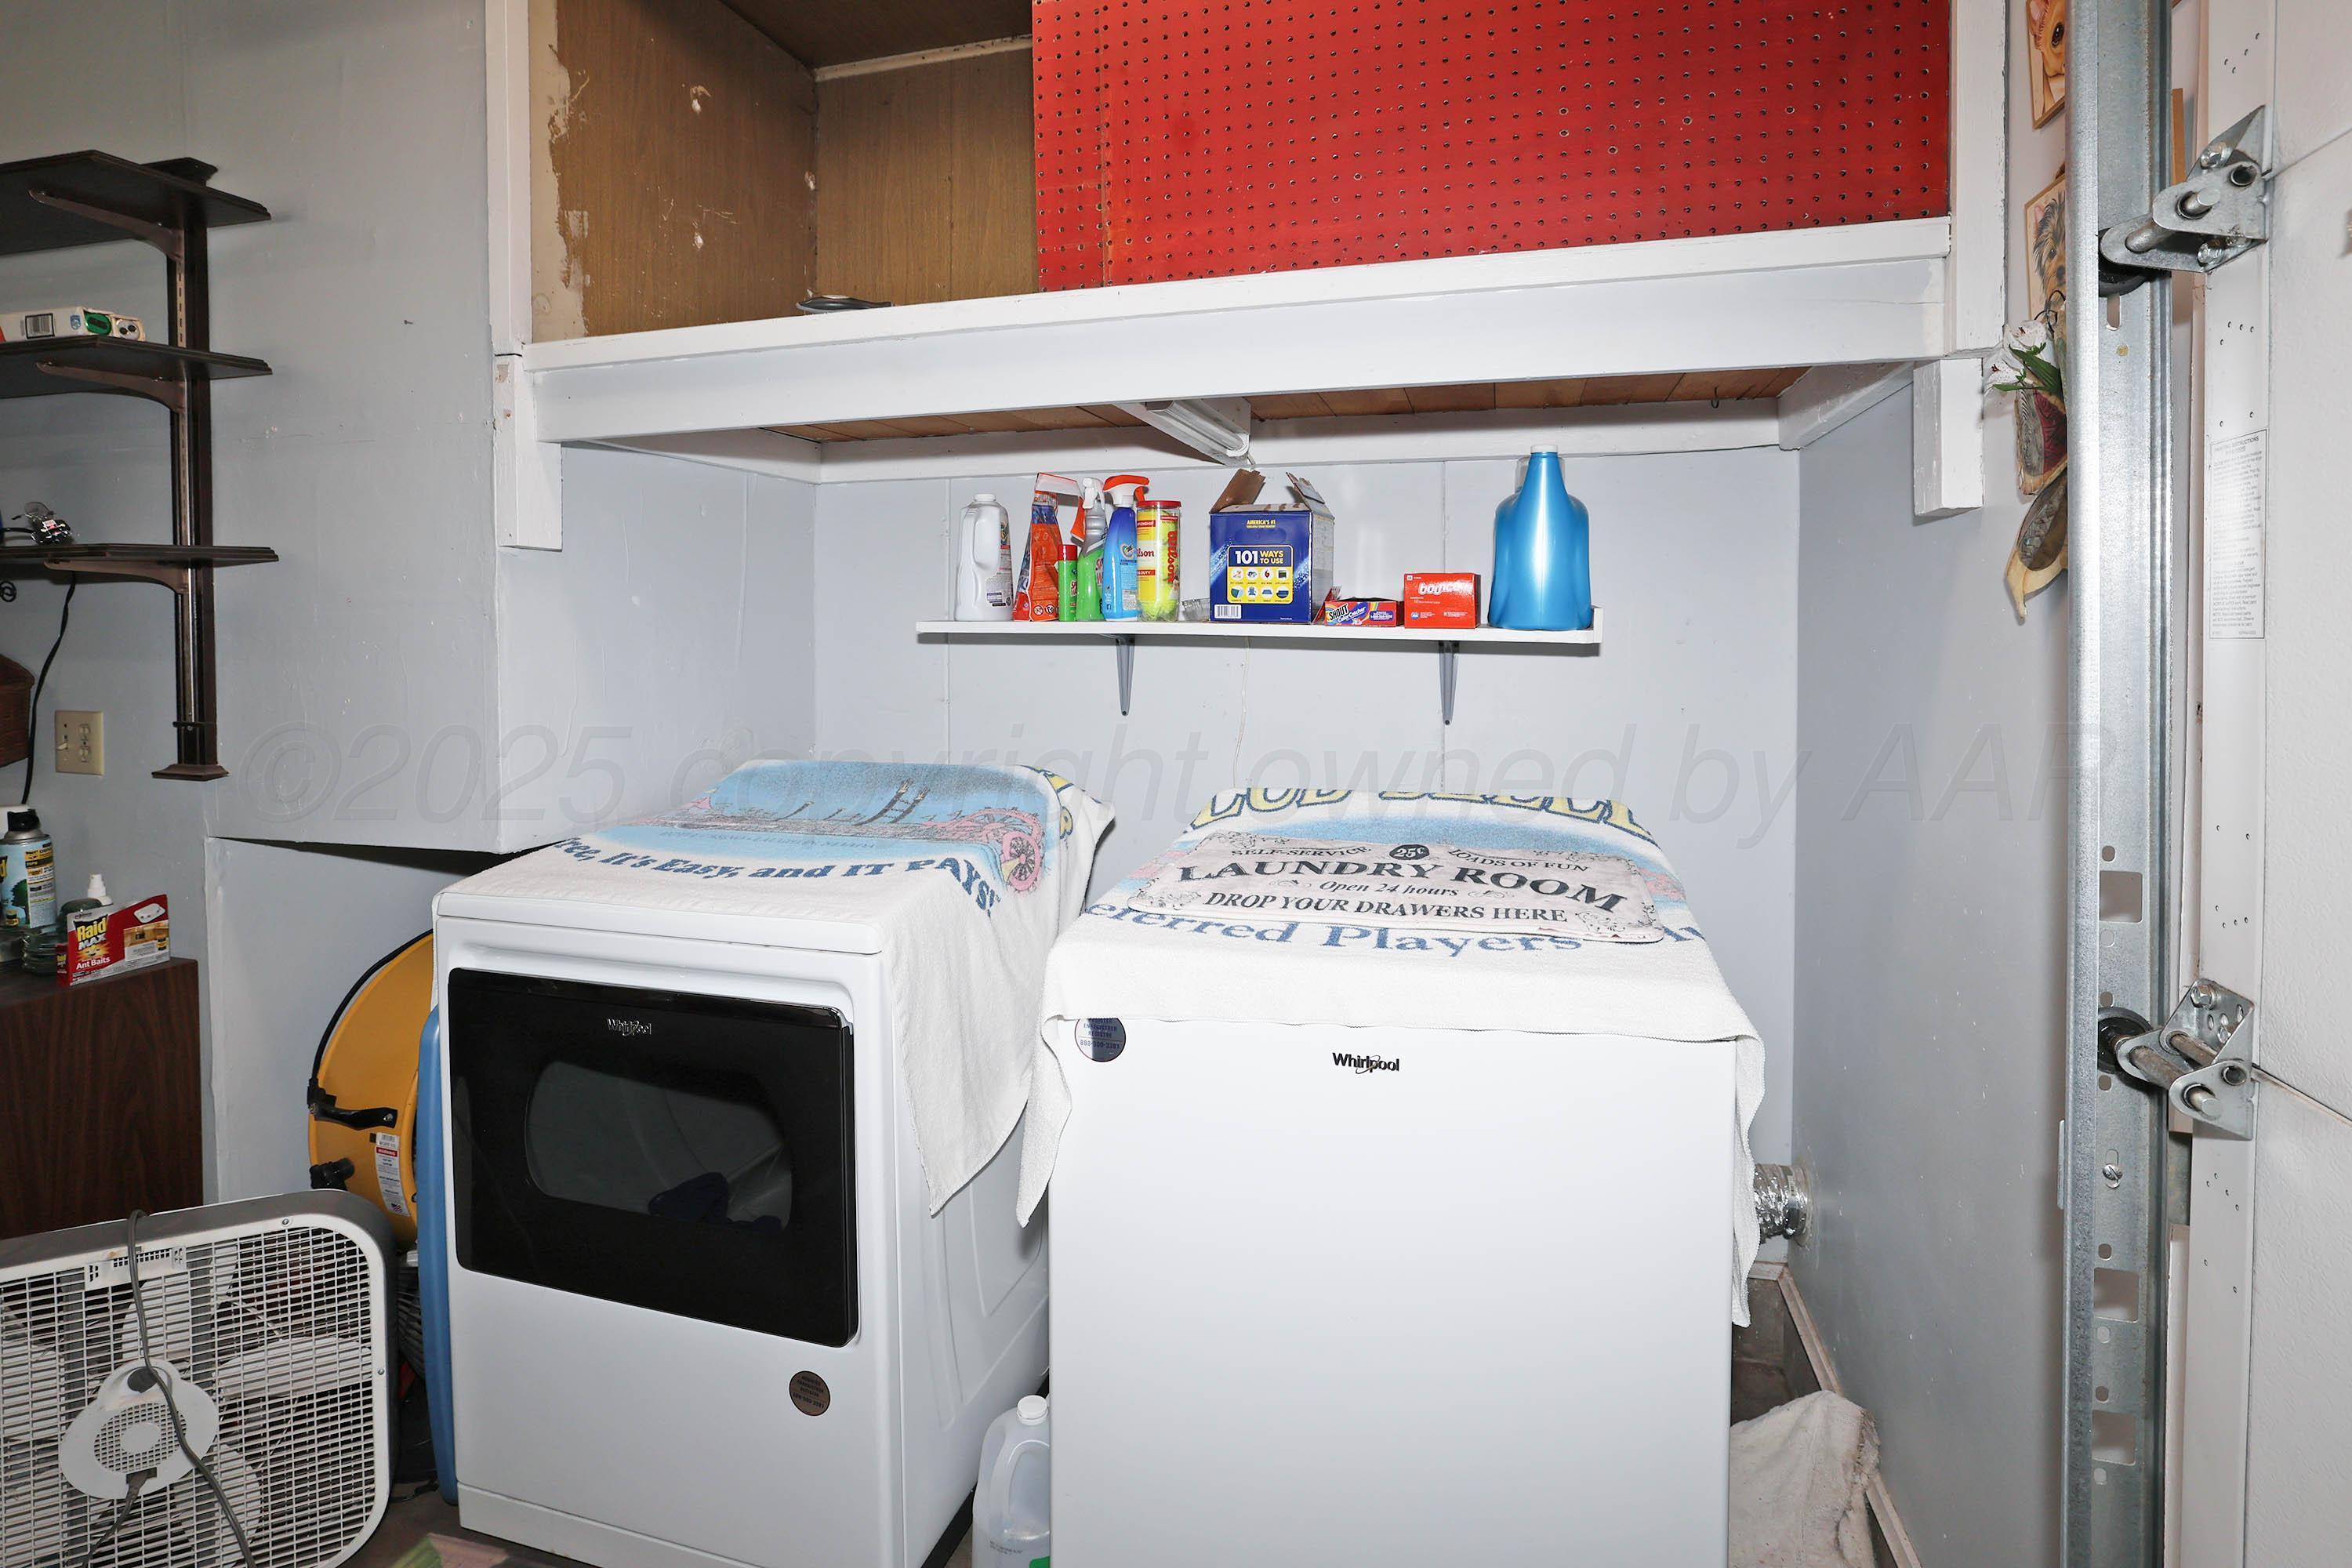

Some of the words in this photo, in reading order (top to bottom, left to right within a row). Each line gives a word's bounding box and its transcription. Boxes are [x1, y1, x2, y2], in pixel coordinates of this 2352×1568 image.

[1167, 531, 1178, 583] Wilson
[1236, 550, 1258, 564] 101
[1329, 604, 1348, 620] SHOUT
[1232, 845, 1371, 858] SELF-SERVICE
[1449, 849, 1513, 867] LOADS
[1544, 862, 1589, 872] FUN
[554, 837, 602, 862] ree,
[598, 852, 657, 868] It's
[652, 858, 745, 879] Easy,
[748, 865, 837, 878] and
[841, 863, 894, 877] IT
[905, 857, 996, 919] PAYS!
[1178, 861, 1444, 882] LAUNDRY
[1450, 866, 1628, 913] ROOM
[1319, 881, 1374, 892] Open
[1379, 883, 1399, 892] 24
[1403, 885, 1458, 898] hours
[1205, 892, 1276, 907] DROP
[1283, 897, 1349, 912] YOUR
[1355, 900, 1485, 919] DRAWERS
[1493, 906, 1568, 922] HERE
[77, 916, 107, 942] Raid
[78, 933, 107, 951] MAX
[1321, 925, 1582, 958] Players
[76, 961, 91, 970] Ant
[91, 956, 111, 966] Baits
[1332, 1052, 1399, 1073] Whirlpool
